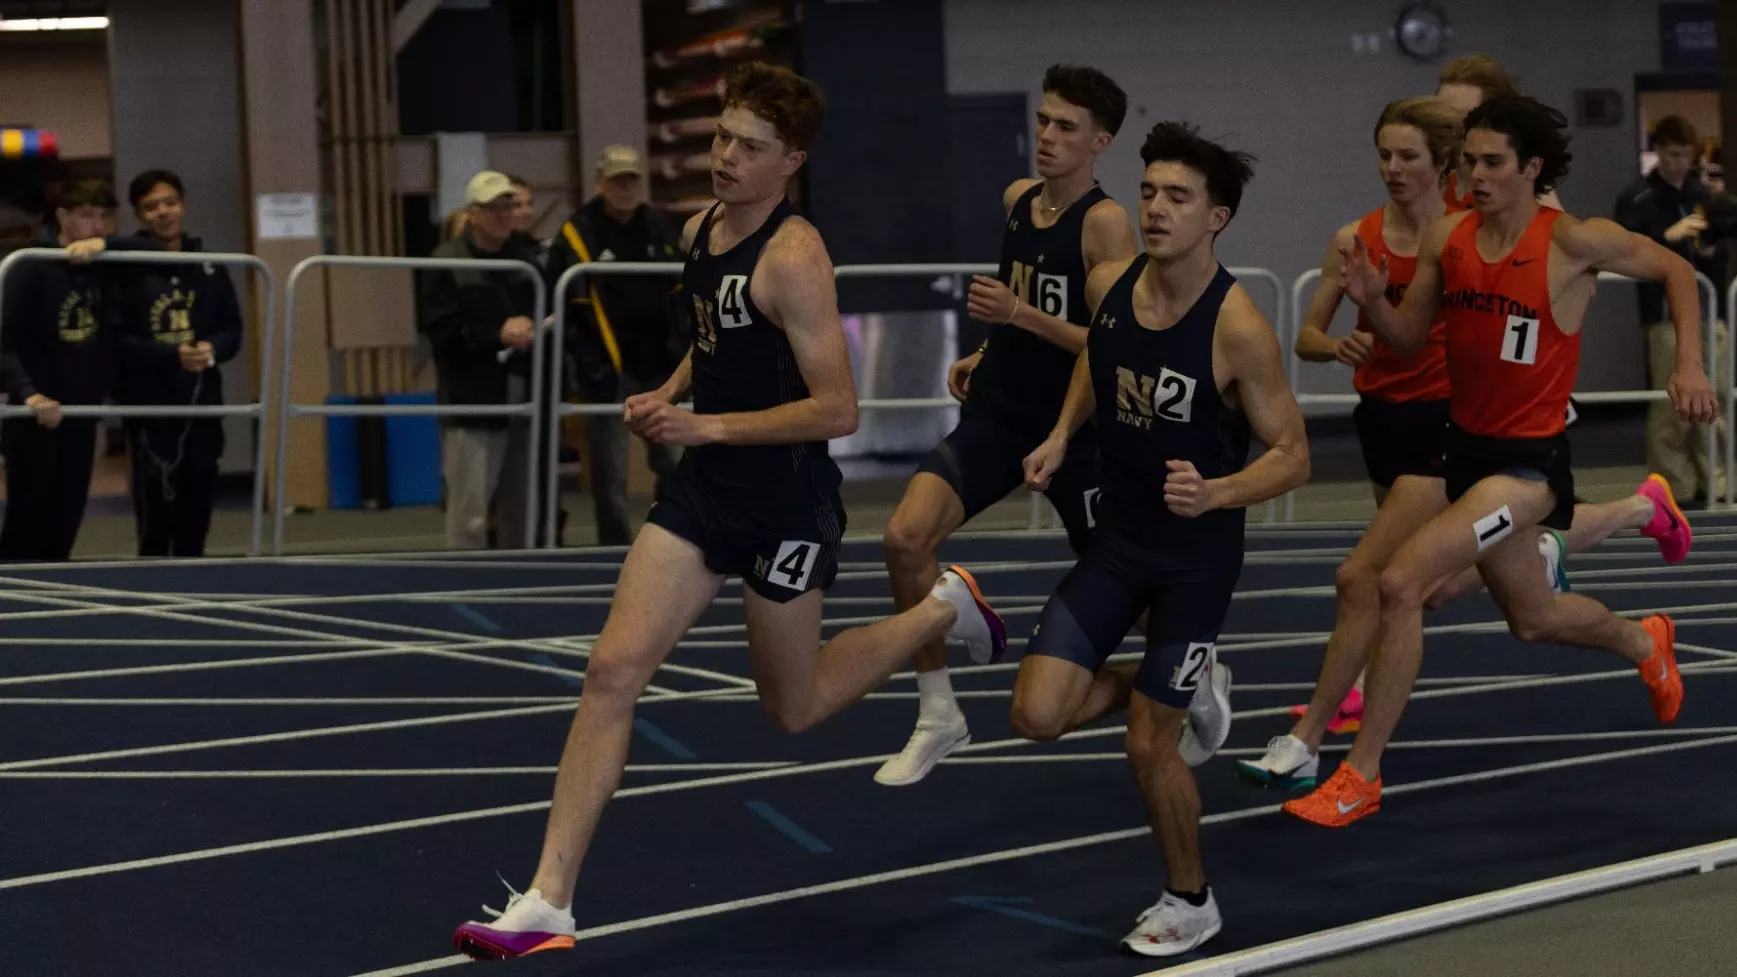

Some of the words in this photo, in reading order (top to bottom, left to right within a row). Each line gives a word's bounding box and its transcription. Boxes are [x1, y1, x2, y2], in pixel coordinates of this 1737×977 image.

[722, 279, 741, 323] 4
[1041, 278, 1062, 316] 6
[1443, 287, 1536, 319] RINCETON
[1511, 322, 1529, 359] 1
[1116, 365, 1155, 418] N
[1158, 376, 1186, 419] 2
[1116, 409, 1152, 430] NAVY
[1480, 514, 1509, 542] 1
[777, 544, 810, 585] 4
[1180, 647, 1207, 687] 2
